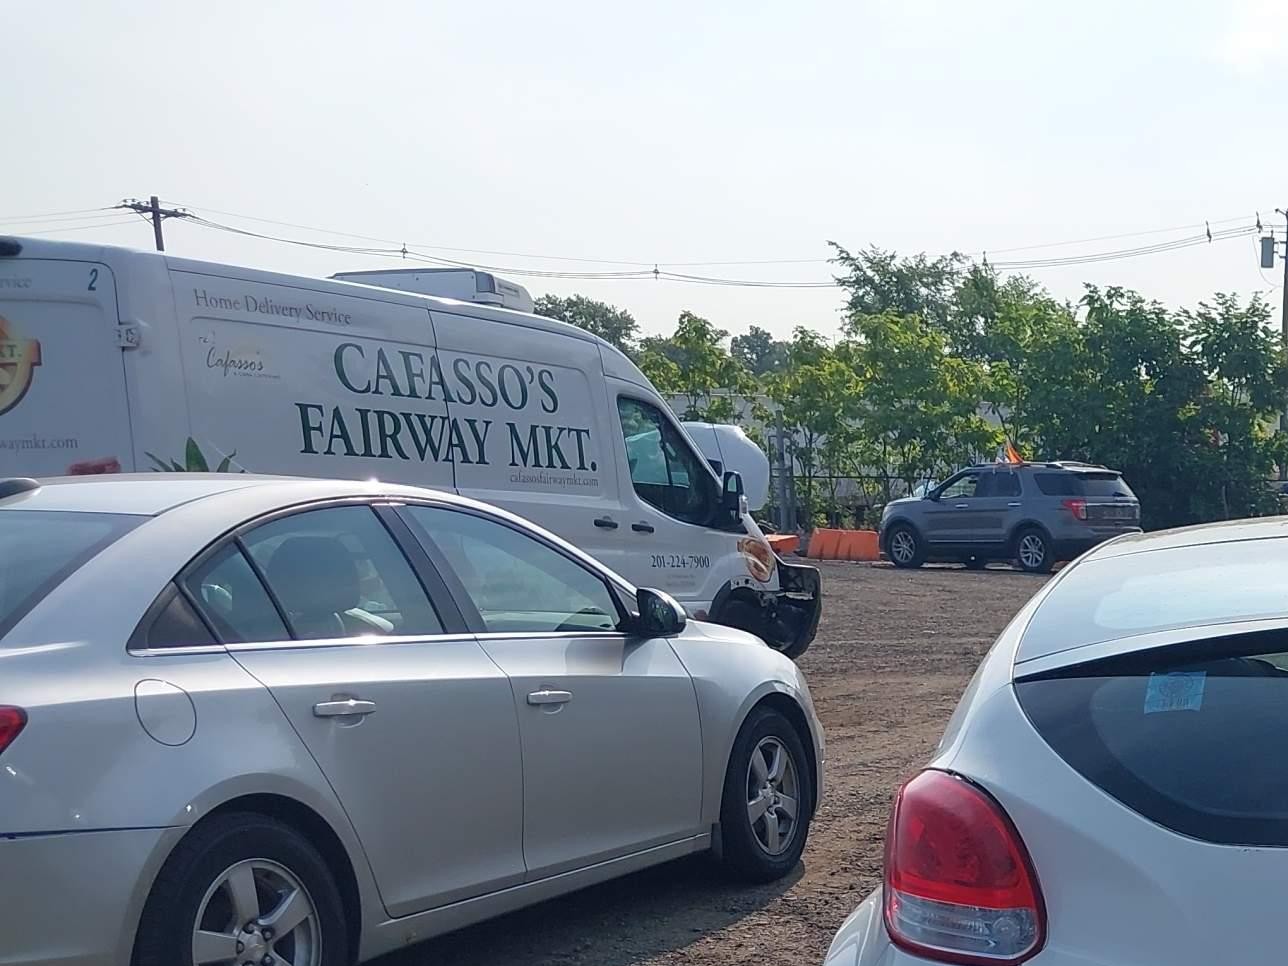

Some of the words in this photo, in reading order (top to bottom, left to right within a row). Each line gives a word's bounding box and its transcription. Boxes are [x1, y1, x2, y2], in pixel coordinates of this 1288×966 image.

[88, 268, 98, 291] 2
[193, 288, 241, 310] Home
[244, 295, 301, 323] Delivery
[306, 304, 352, 325] Service
[334, 342, 559, 414] CAFASSO'S
[295, 402, 493, 465] FAIRWAY
[506, 421, 598, 472] MKT.
[651, 554, 710, 568] 201-224-7900
